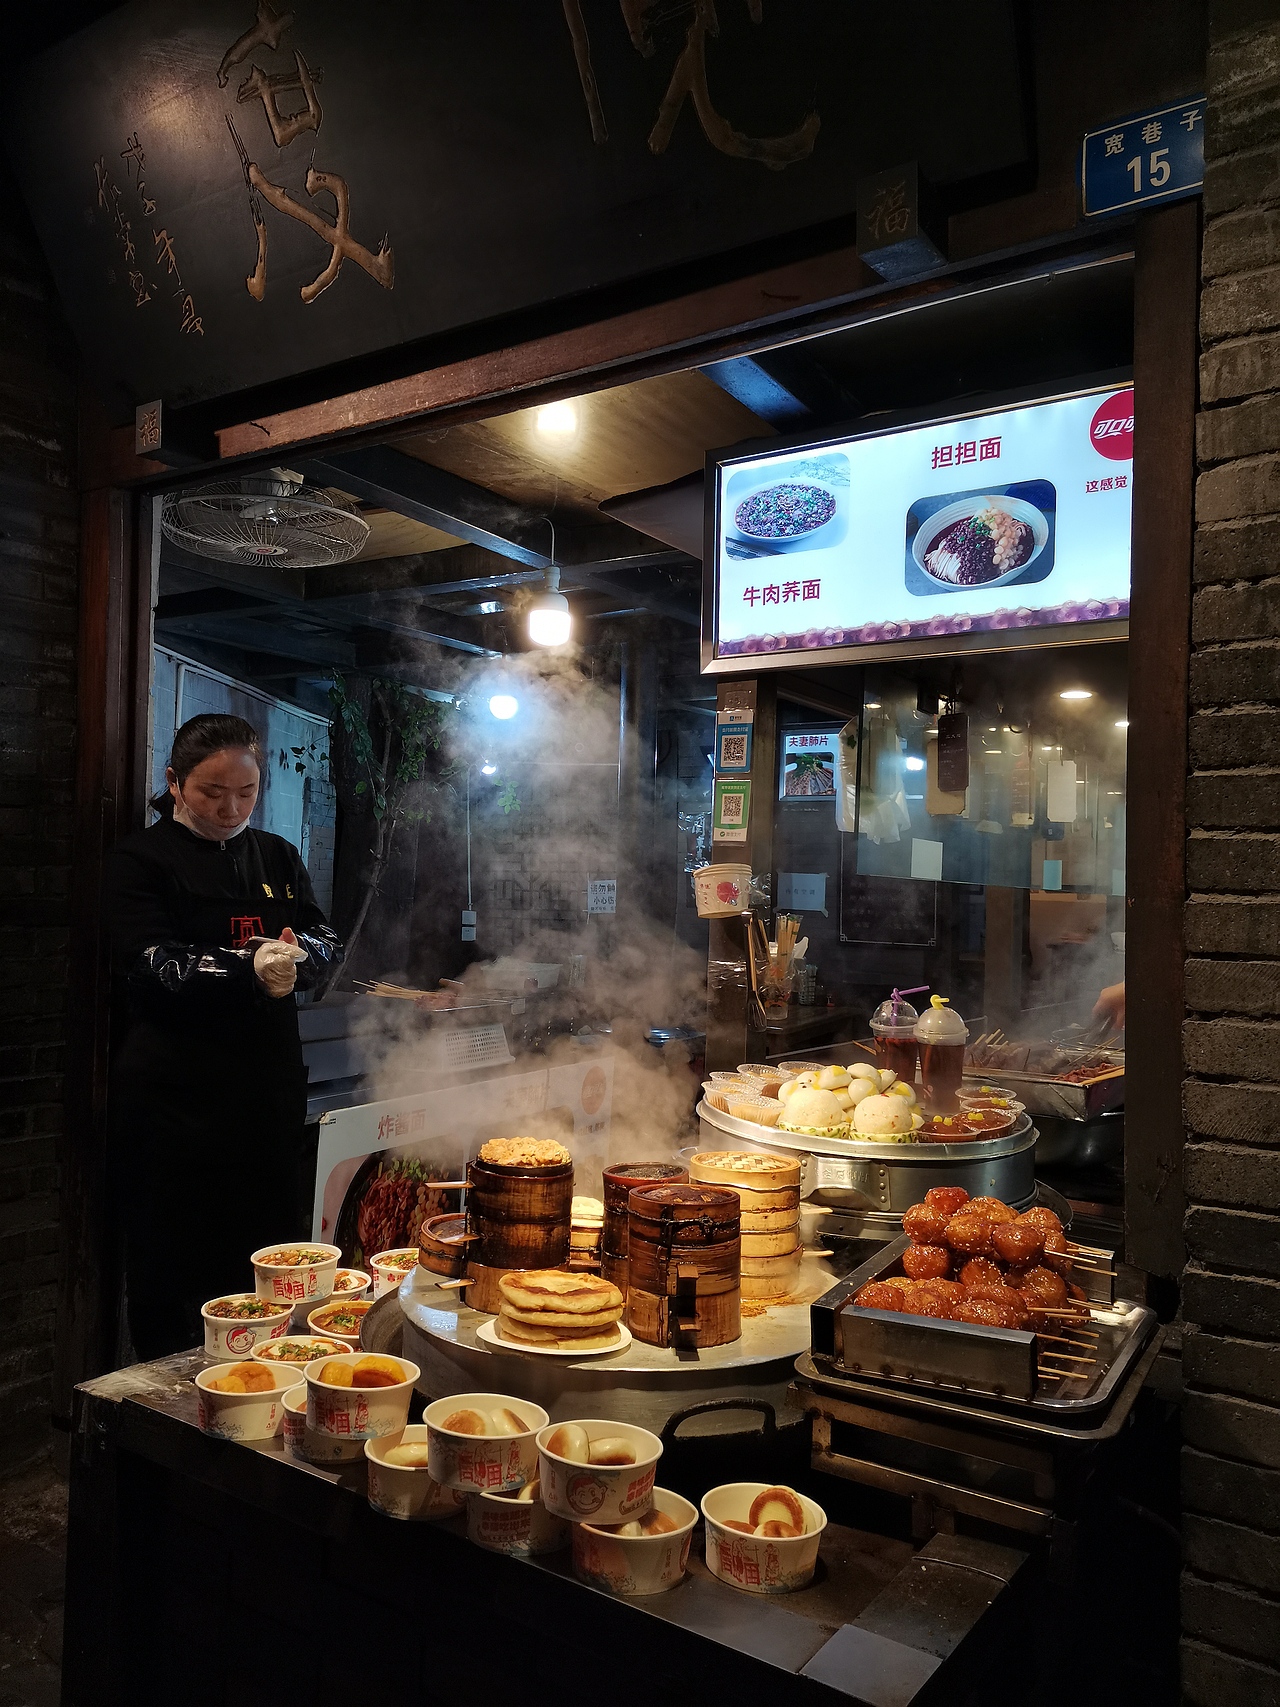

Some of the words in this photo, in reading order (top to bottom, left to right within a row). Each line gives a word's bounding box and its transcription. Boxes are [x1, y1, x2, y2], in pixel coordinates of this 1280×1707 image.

[1104, 109, 1202, 157] 宽巷子
[1127, 147, 1171, 193] 15
[863, 180, 911, 240] 福
[138, 409, 159, 447] 福
[931, 436, 1002, 470] 担担面
[1085, 476, 1128, 493] 这感觉
[742, 578, 822, 608] 牛肉荞面
[788, 735, 829, 748] 夫妻肺片
[377, 1108, 427, 1140] 炸酱面
